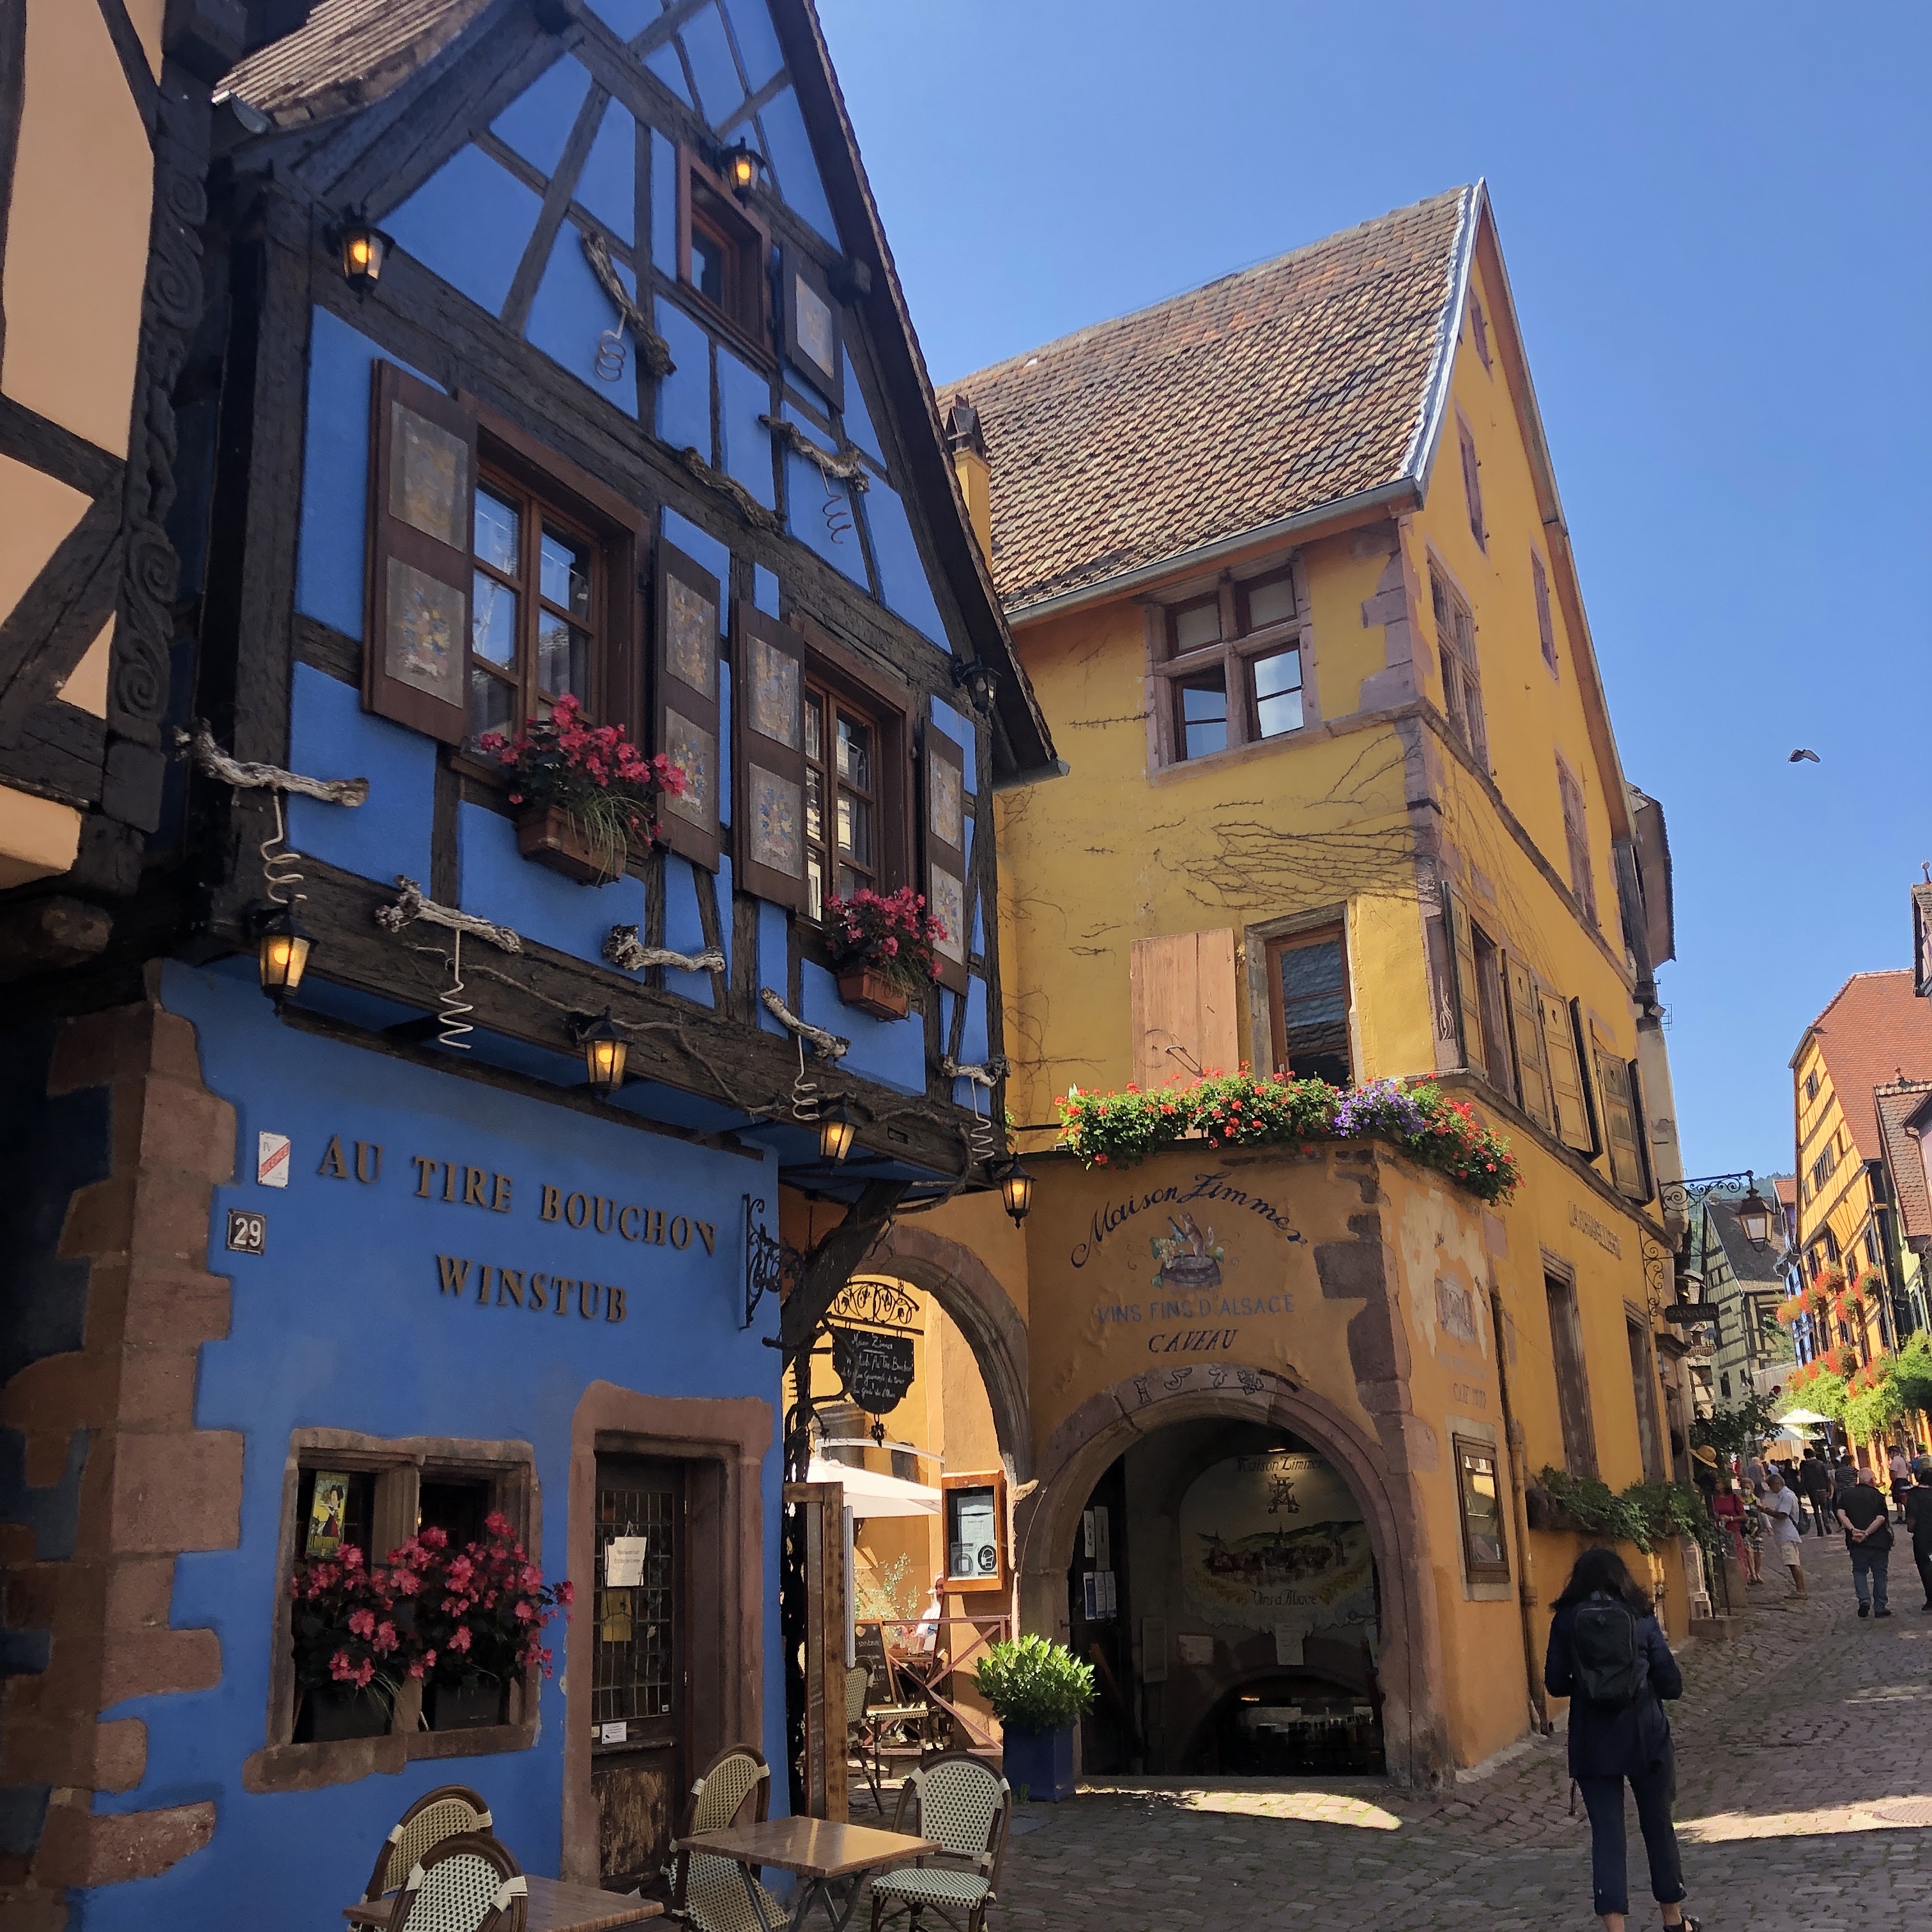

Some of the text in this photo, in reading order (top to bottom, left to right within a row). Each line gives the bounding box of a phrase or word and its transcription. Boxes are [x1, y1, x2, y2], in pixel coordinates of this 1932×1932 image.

[318, 1133, 716, 1258] AU TIRE BOUCHON
[1071, 1171, 1308, 1268] Maison Zimmer
[234, 1218, 261, 1246] 29
[436, 1254, 628, 1322] WINSTUB
[1096, 1293, 1295, 1324] VINS FINS D'ALSACE
[1147, 1328, 1239, 1353] CAVEAU
